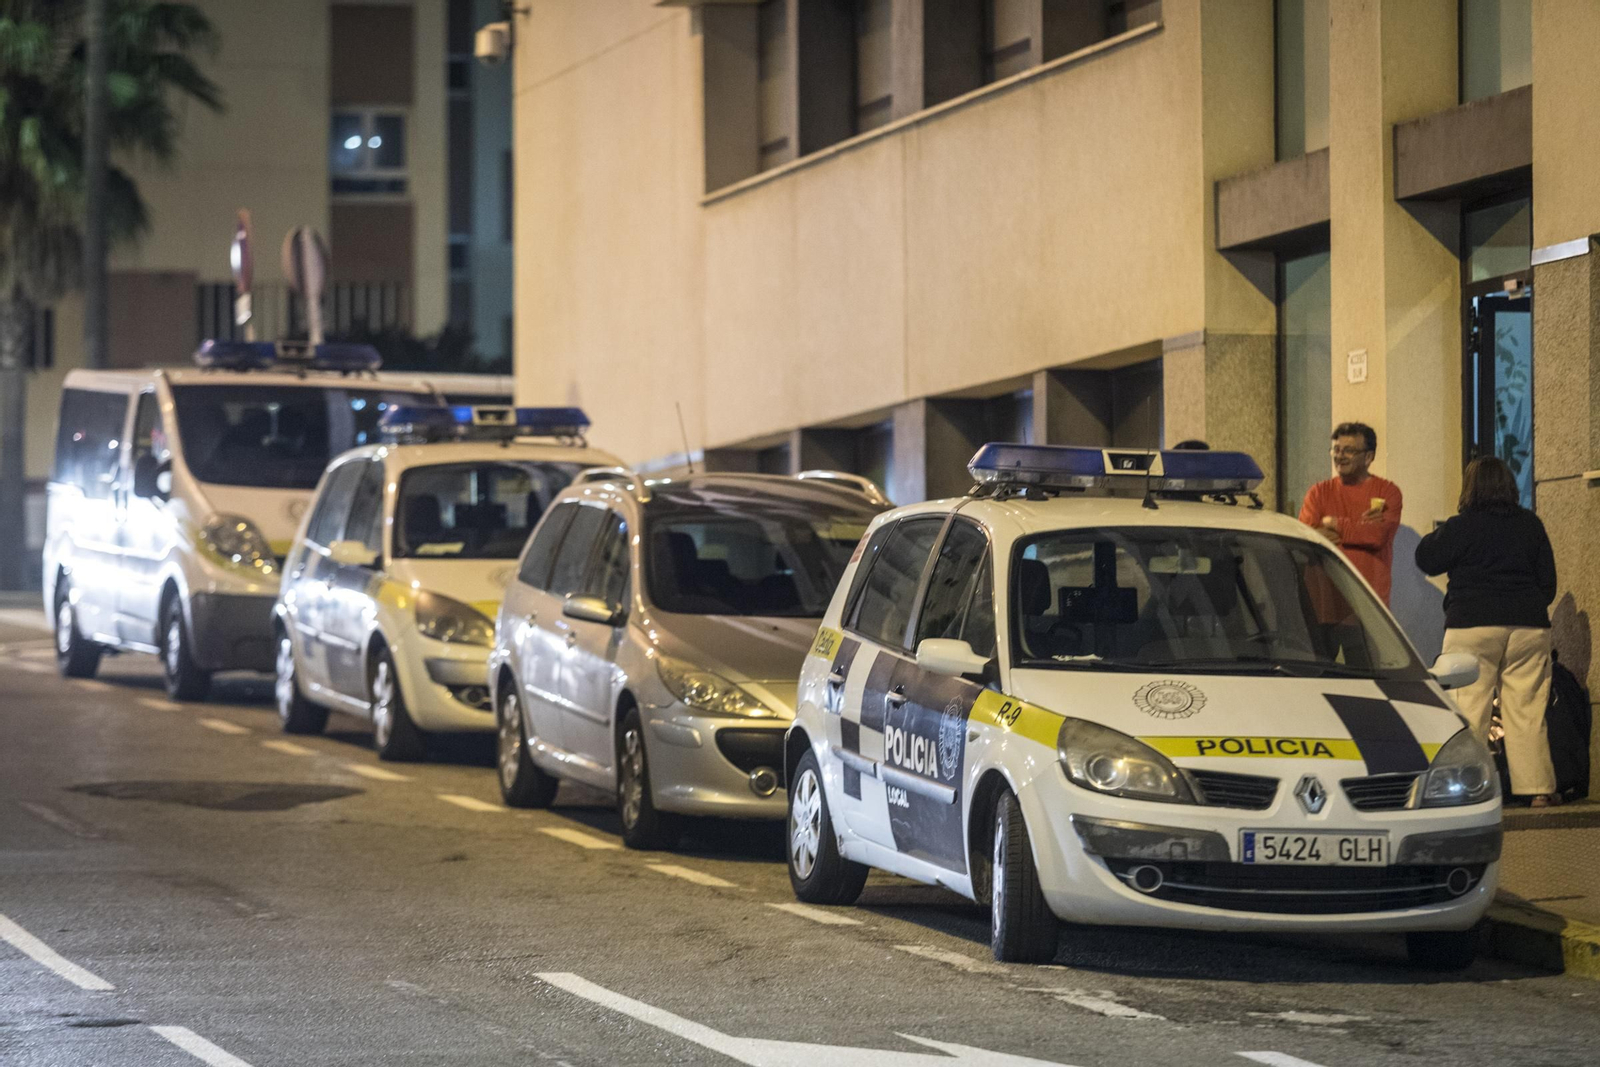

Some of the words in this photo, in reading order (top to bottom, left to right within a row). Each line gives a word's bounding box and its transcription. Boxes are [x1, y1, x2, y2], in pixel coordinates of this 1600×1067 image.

[997, 702, 1021, 726] R-9
[885, 725, 938, 778] POLICIA
[1195, 737, 1335, 758] POLICIA
[887, 785, 910, 808] LOCAL
[1263, 836, 1322, 861] 5424
[1339, 838, 1382, 862] GLH
